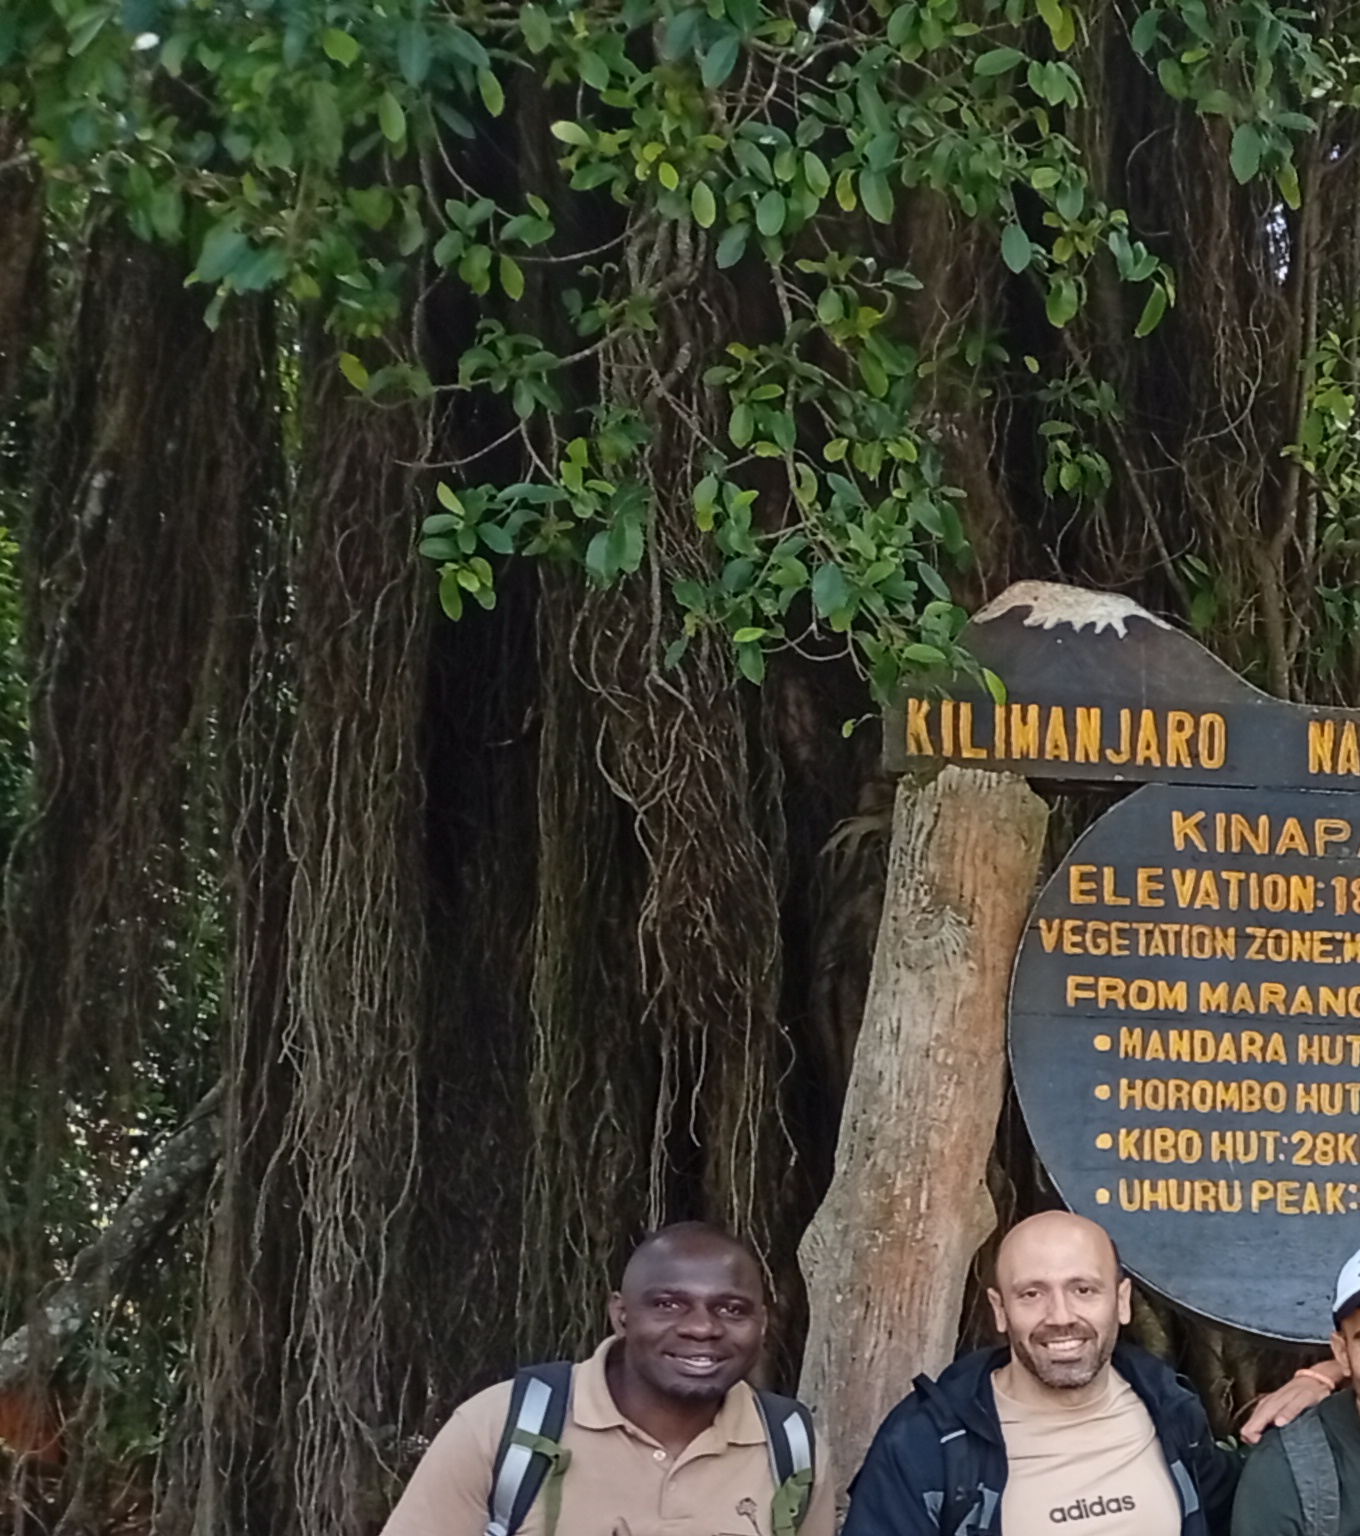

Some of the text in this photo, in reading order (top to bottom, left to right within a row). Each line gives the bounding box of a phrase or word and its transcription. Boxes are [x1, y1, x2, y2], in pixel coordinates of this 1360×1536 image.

[905, 697, 1227, 770] KILIMANJARO
[1038, 917, 1237, 961] VEGETATION
[1066, 974, 1189, 1012] FROM
[1118, 1026, 1288, 1066] MANDARA
[1118, 1077, 1288, 1114] HOROMBO
[1118, 1127, 1203, 1164] KIBO
[1118, 1177, 1243, 1213] UHURU
[1049, 1494, 1137, 1524] adidas
